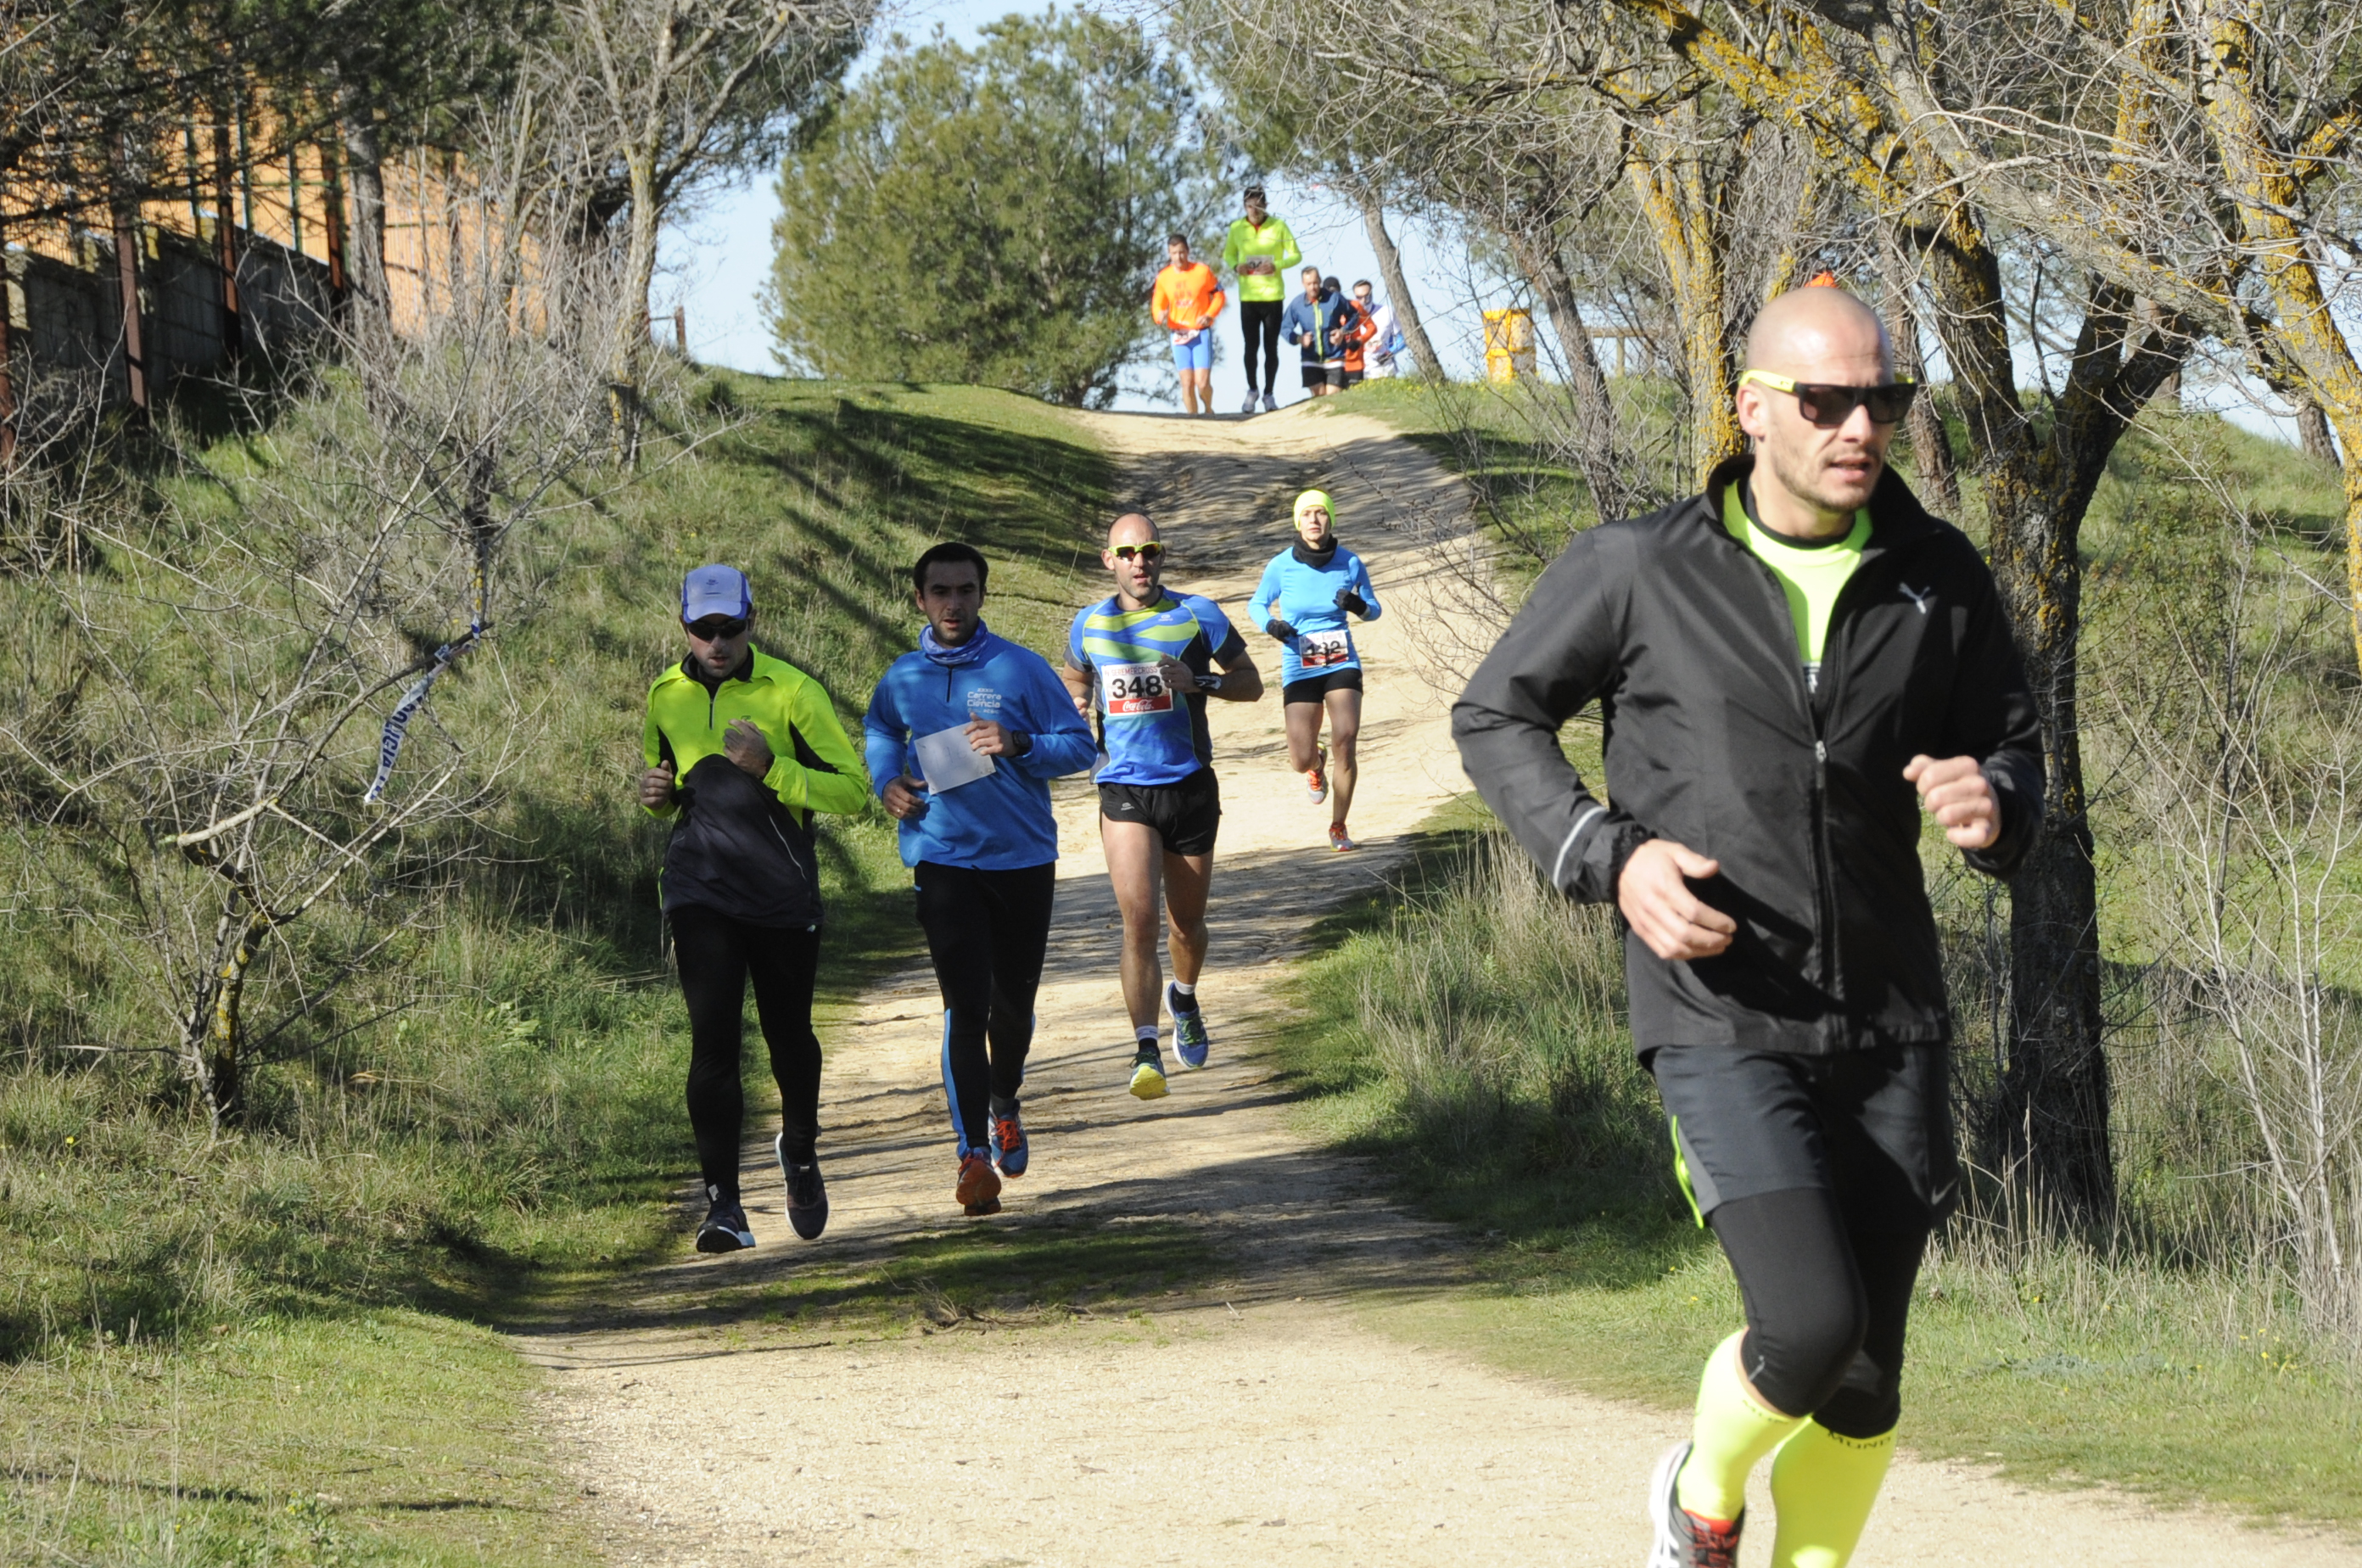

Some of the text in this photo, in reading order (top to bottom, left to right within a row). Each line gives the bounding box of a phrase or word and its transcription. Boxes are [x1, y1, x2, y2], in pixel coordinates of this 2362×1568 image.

[1112, 675, 1162, 698] 348
[967, 692, 1002, 700] Carrera
[967, 699, 1000, 708] Ciencia
